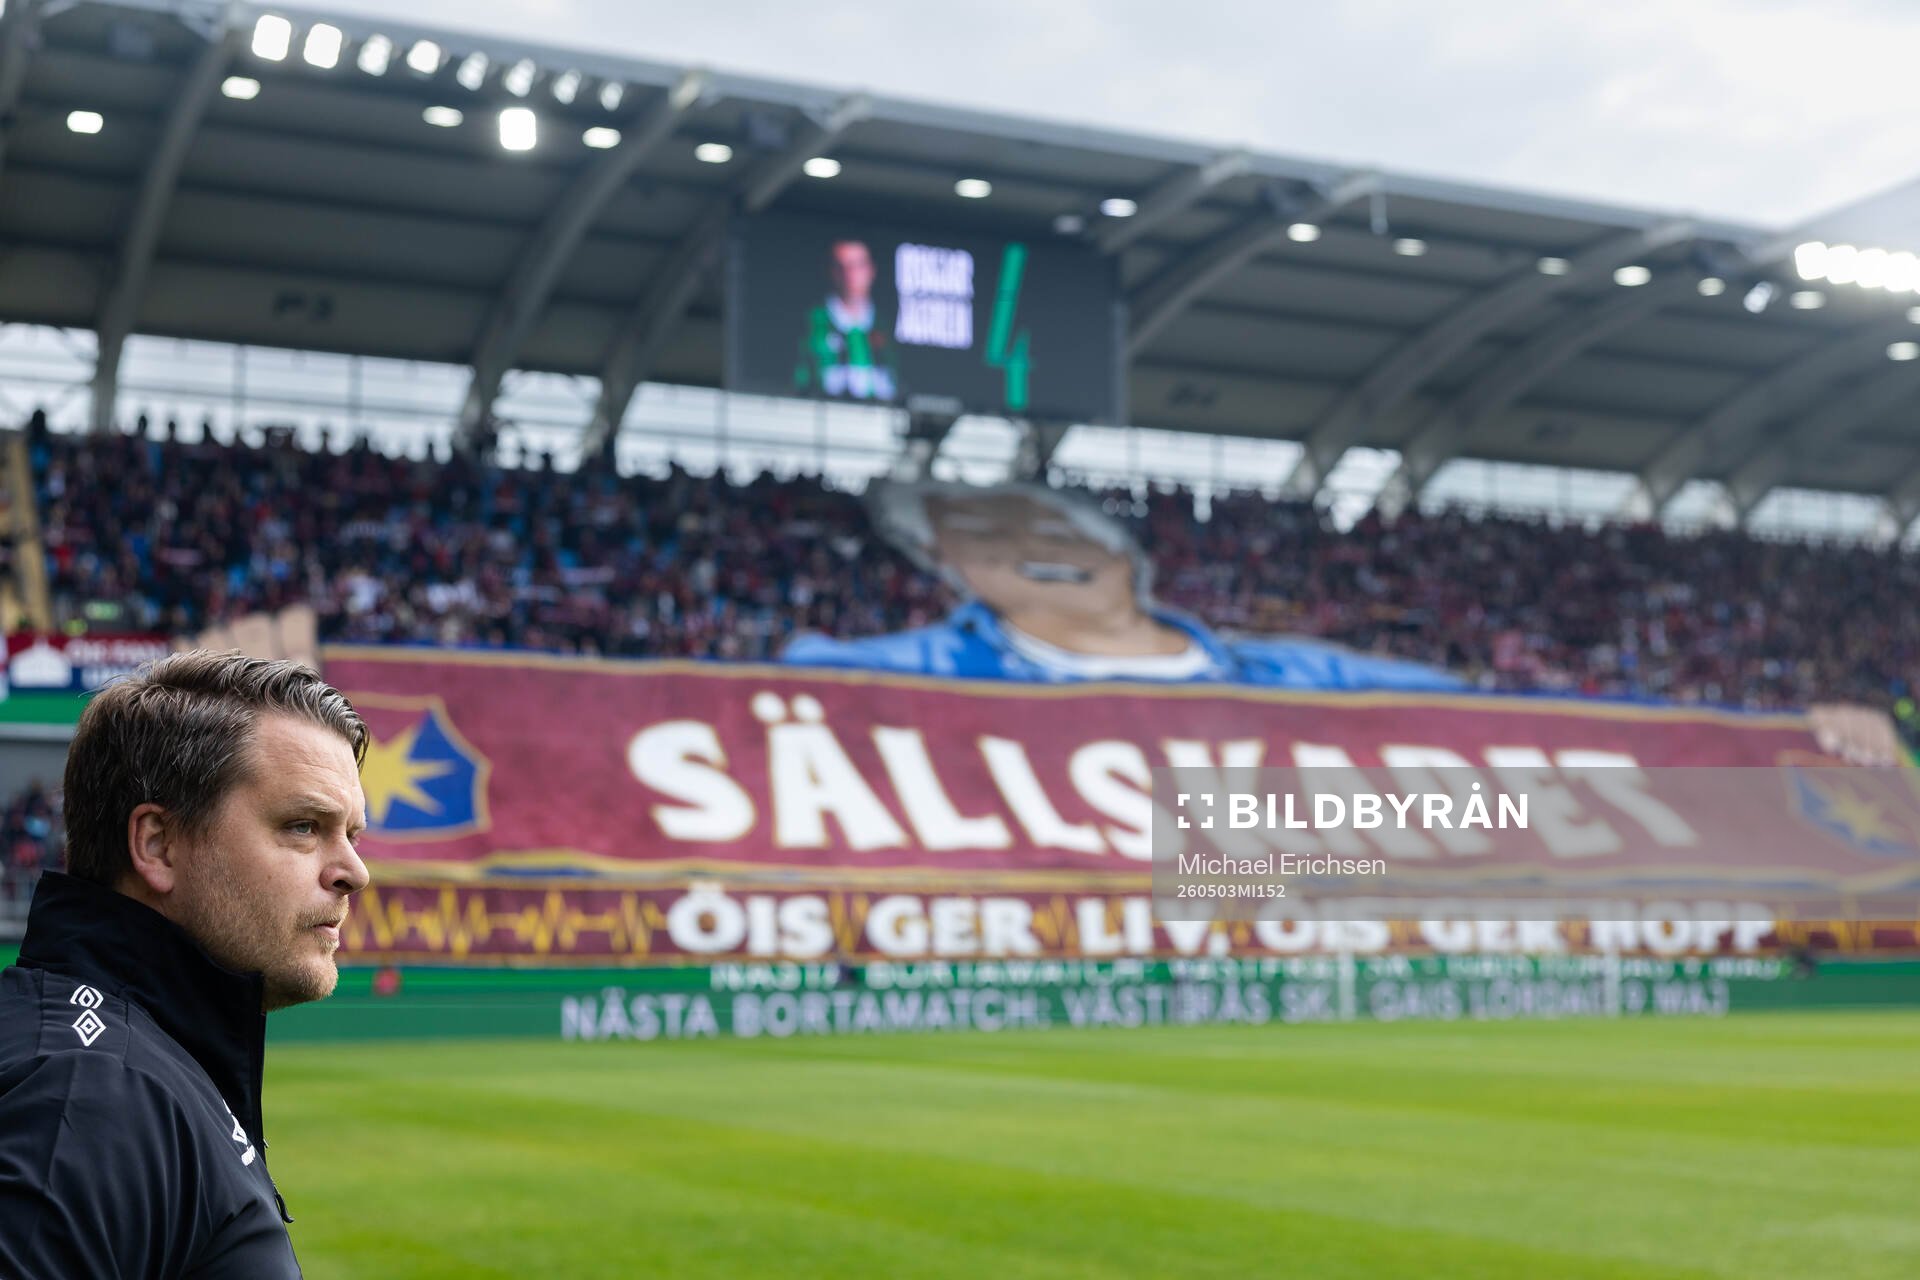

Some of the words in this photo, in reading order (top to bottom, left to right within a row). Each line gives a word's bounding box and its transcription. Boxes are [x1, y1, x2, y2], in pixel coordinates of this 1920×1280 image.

[987, 243, 1030, 408] 4
[627, 691, 1697, 862] SÄLLSKAPET
[666, 883, 834, 958] ÖIS
[866, 894, 1042, 957] GER
[1418, 898, 1565, 953] GER
[1588, 898, 1774, 955] HOPP
